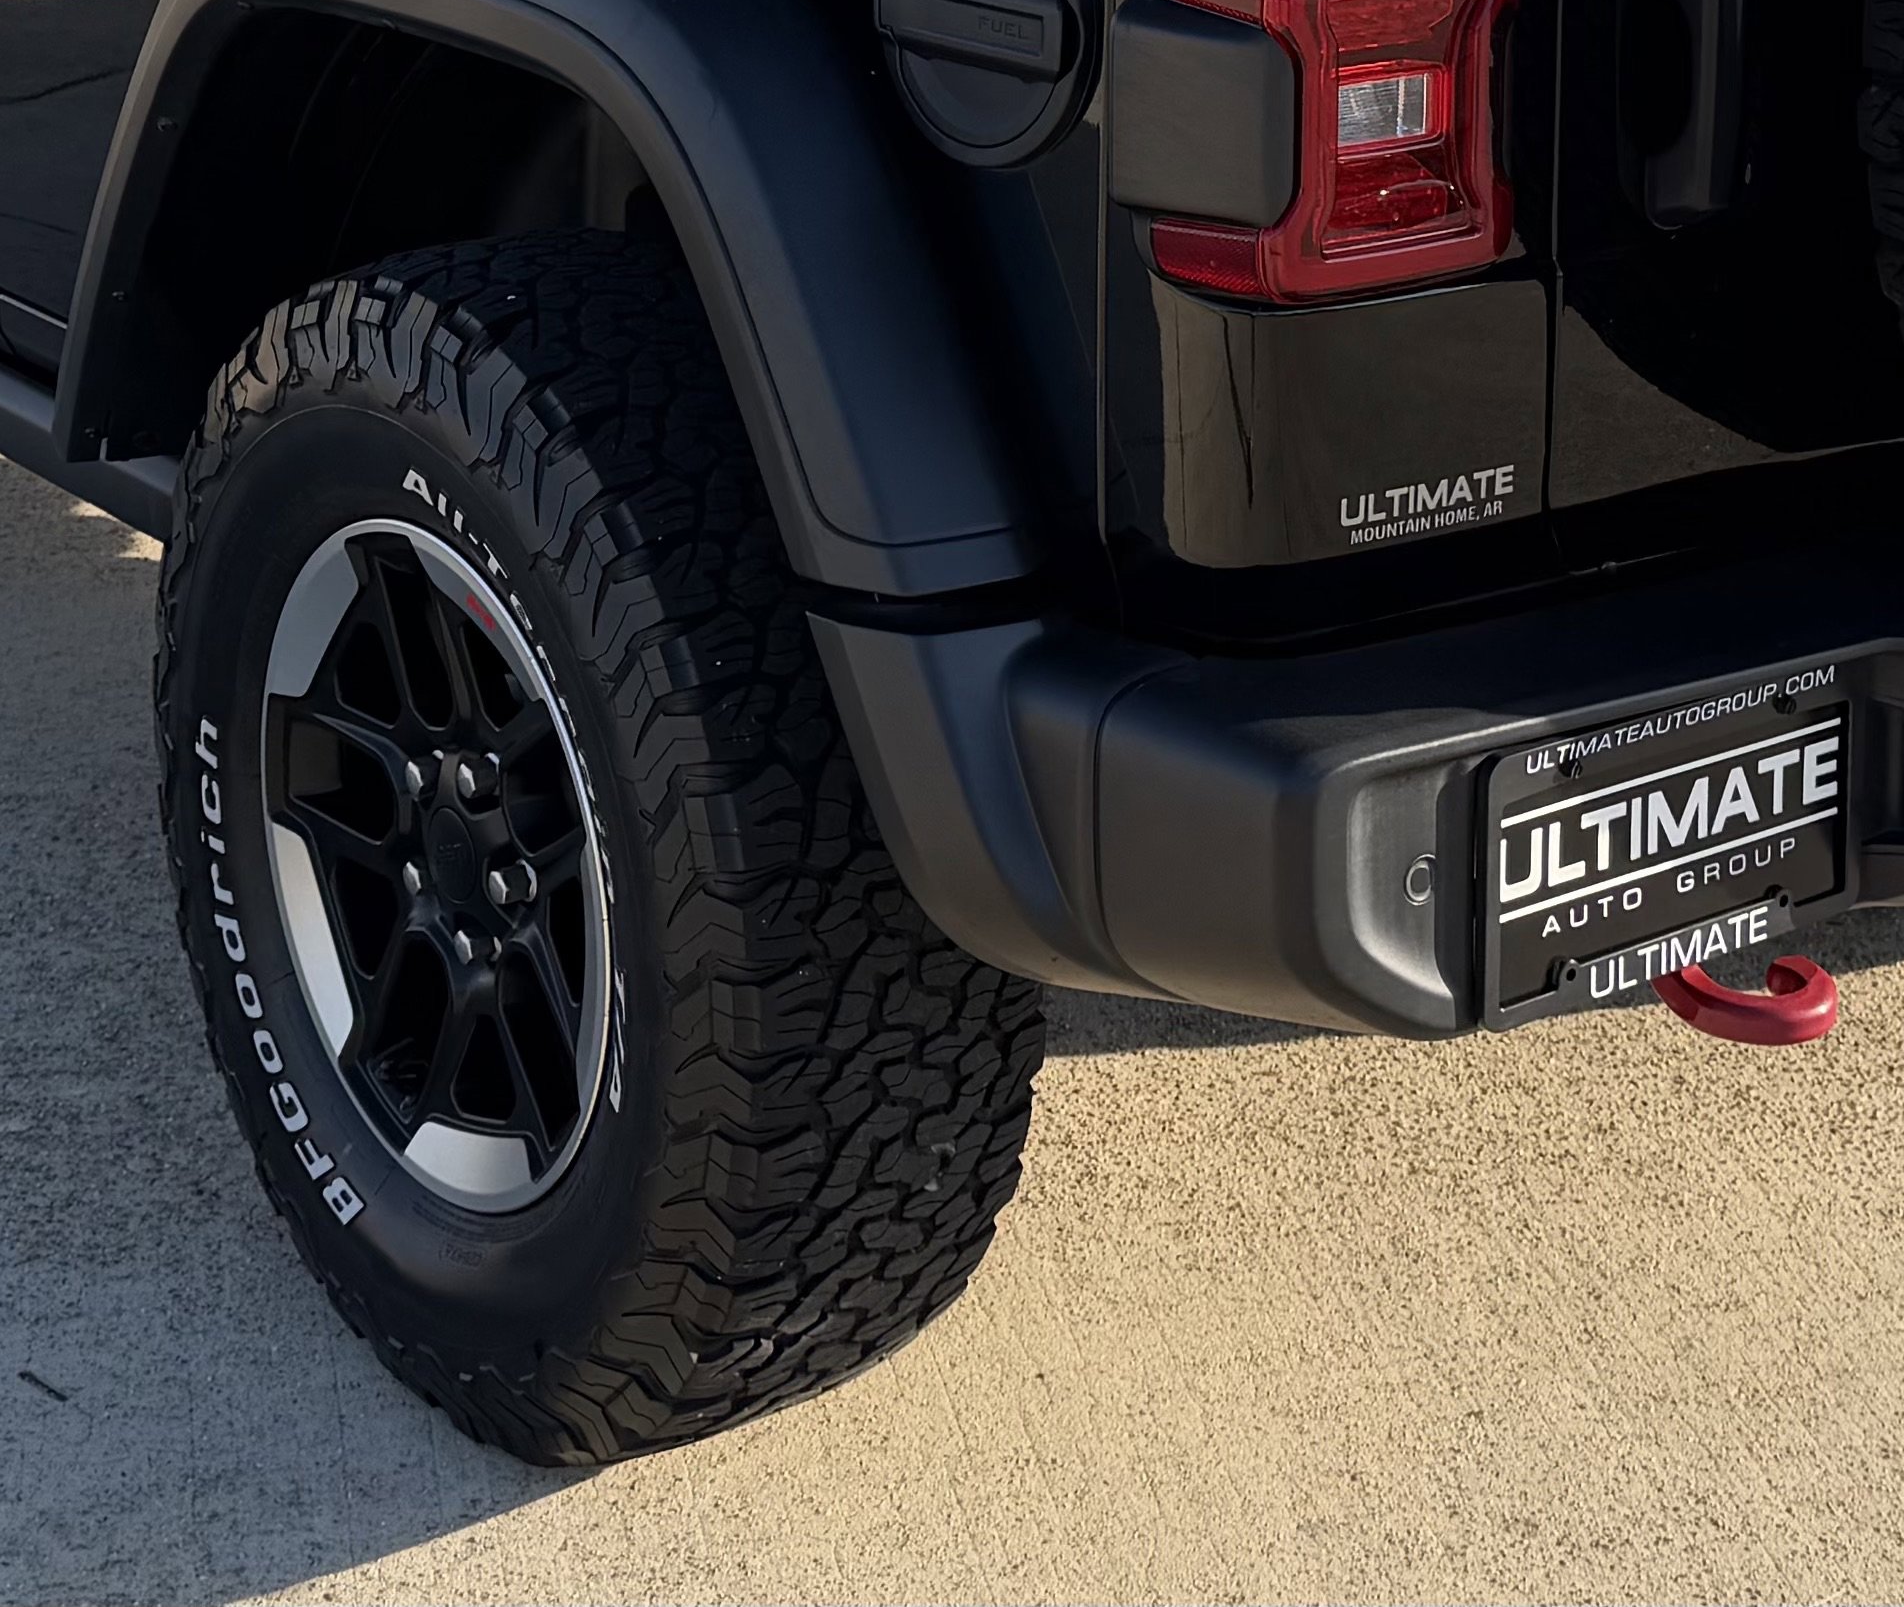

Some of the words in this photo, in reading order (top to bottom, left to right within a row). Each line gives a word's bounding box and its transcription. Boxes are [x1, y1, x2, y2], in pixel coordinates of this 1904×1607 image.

[978, 15, 1029, 40] FUEL
[1341, 464, 1514, 527] ULTIMATE
[1350, 516, 1431, 545] MOUNTAIN
[1434, 505, 1481, 529] HOME,
[1483, 500, 1503, 518] AR
[1525, 664, 1836, 775] ULTIMATEAUTOGROUP.COM
[1499, 736, 1840, 903] ULTIMATE
[1541, 887, 1643, 938] AUTO
[1675, 837, 1797, 894] GROUP
[195, 715, 367, 1227] BFGoodrich
[1589, 905, 1769, 999] ULTIMATE
